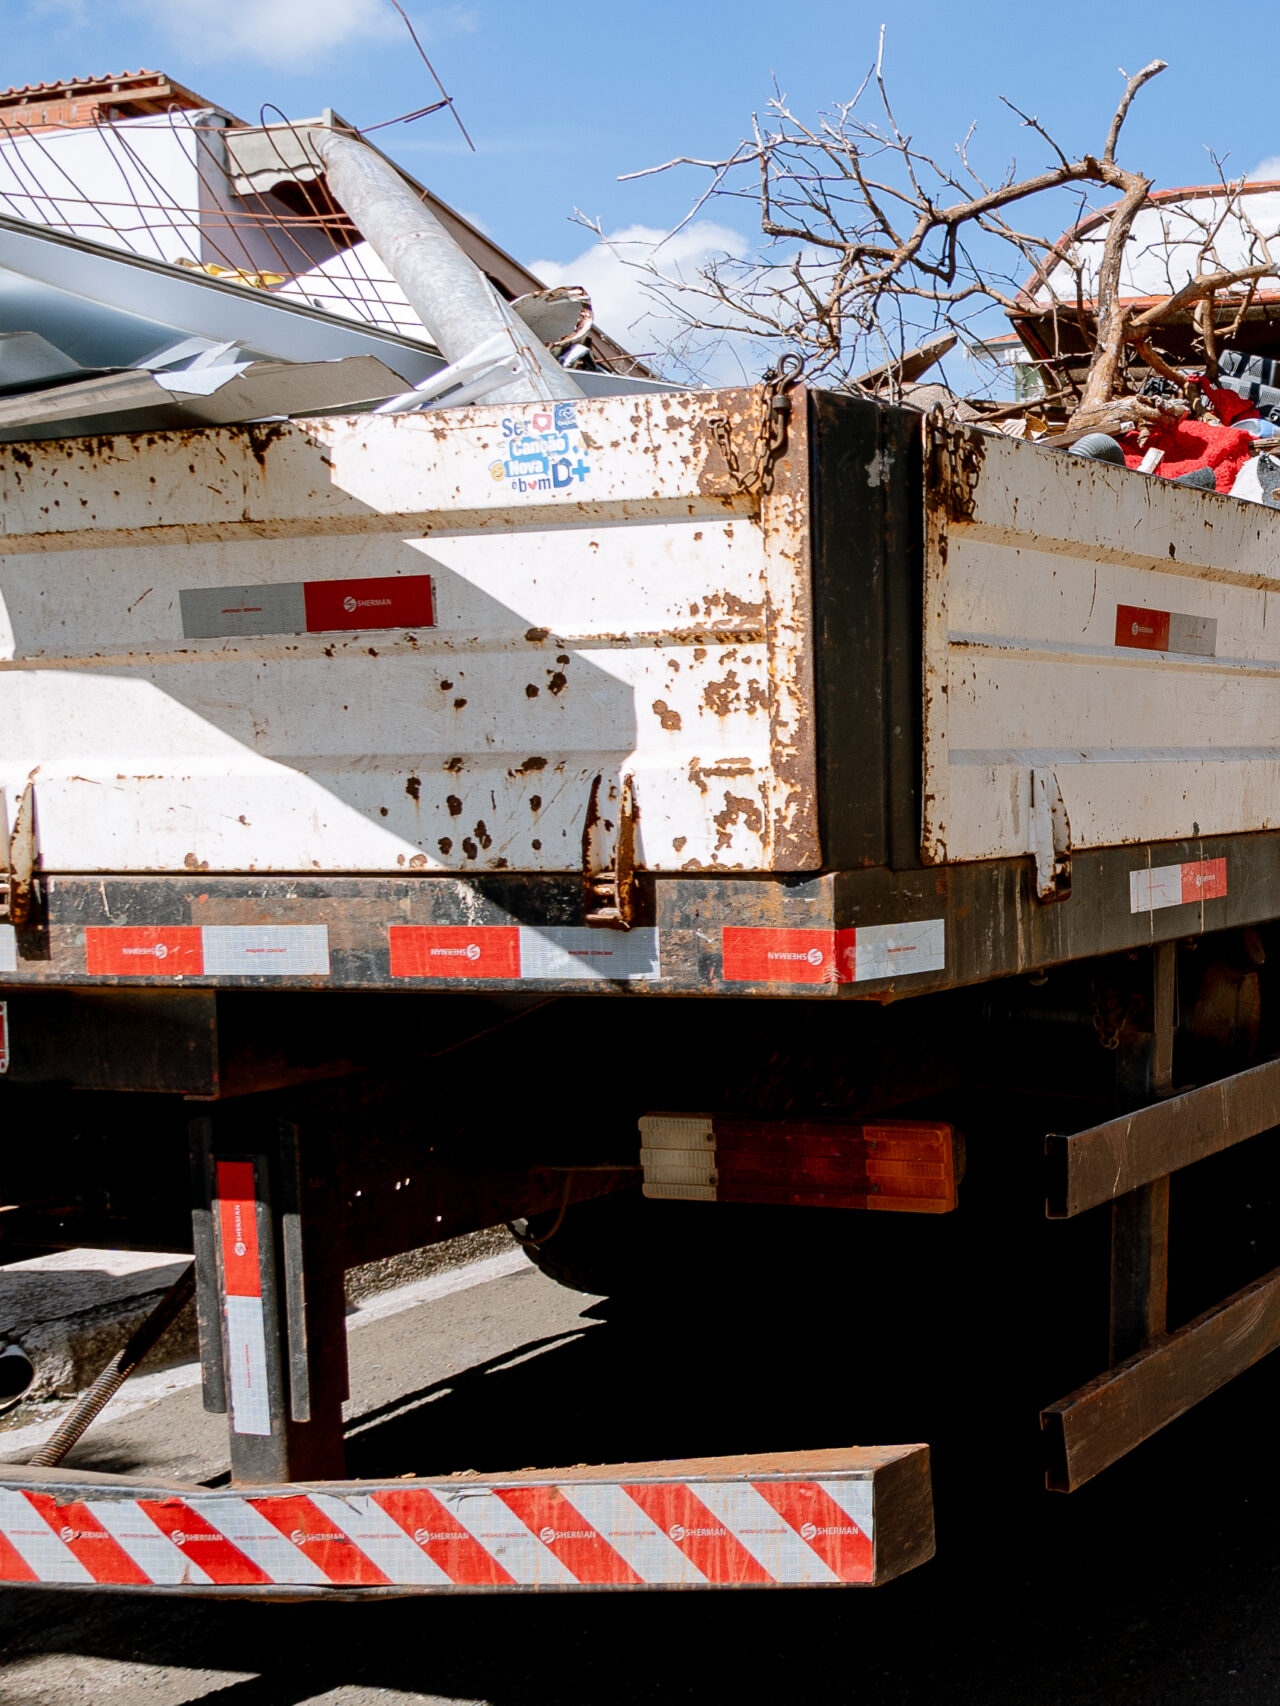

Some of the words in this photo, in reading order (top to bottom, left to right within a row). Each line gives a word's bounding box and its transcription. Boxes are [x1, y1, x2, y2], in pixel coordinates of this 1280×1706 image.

[357, 599, 392, 607] SHERMAN
[767, 951, 808, 961] SHERMAN
[234, 1204, 242, 1242] SHERMAN
[429, 1532, 469, 1541] SHERMAN
[555, 1530, 597, 1540] SHERMAN
[685, 1528, 727, 1538] SHERMAN
[816, 1526, 859, 1537] SHERMAN
[185, 1533, 224, 1542] SHERMAN
[306, 1533, 345, 1542] SHERMAN
